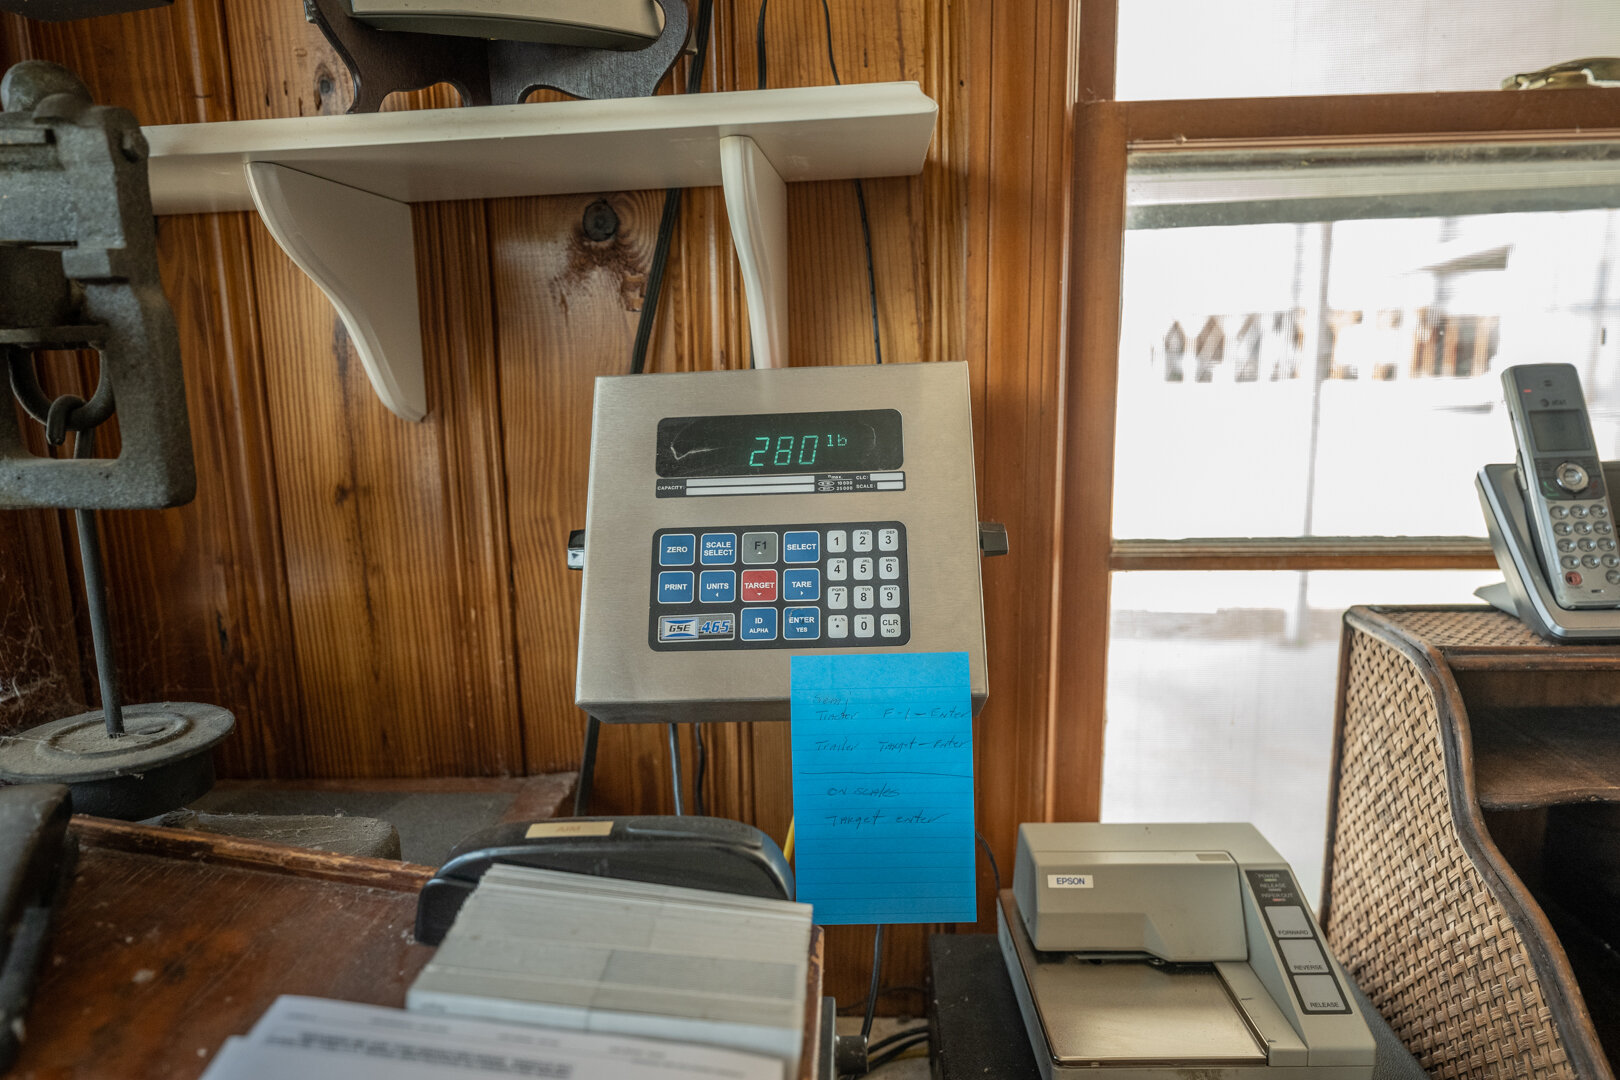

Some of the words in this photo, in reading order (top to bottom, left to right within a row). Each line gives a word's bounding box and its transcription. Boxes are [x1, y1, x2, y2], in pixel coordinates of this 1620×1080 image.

[749, 435, 819, 466] 280
[827, 434, 848, 446] lb
[834, 537, 839, 546] 1
[859, 536, 866, 545] 2
[885, 536, 892, 544] 3
[754, 541, 767, 550] F1
[834, 564, 840, 574] 4
[860, 564, 867, 573] 5
[886, 564, 892, 572] 6
[834, 593, 841, 602] 7
[860, 592, 867, 602] 8
[886, 592, 893, 601] 9
[668, 624, 691, 633] GSE
[702, 620, 731, 633] 465
[861, 621, 867, 630] 0
[1056, 877, 1085, 885] EPSON
